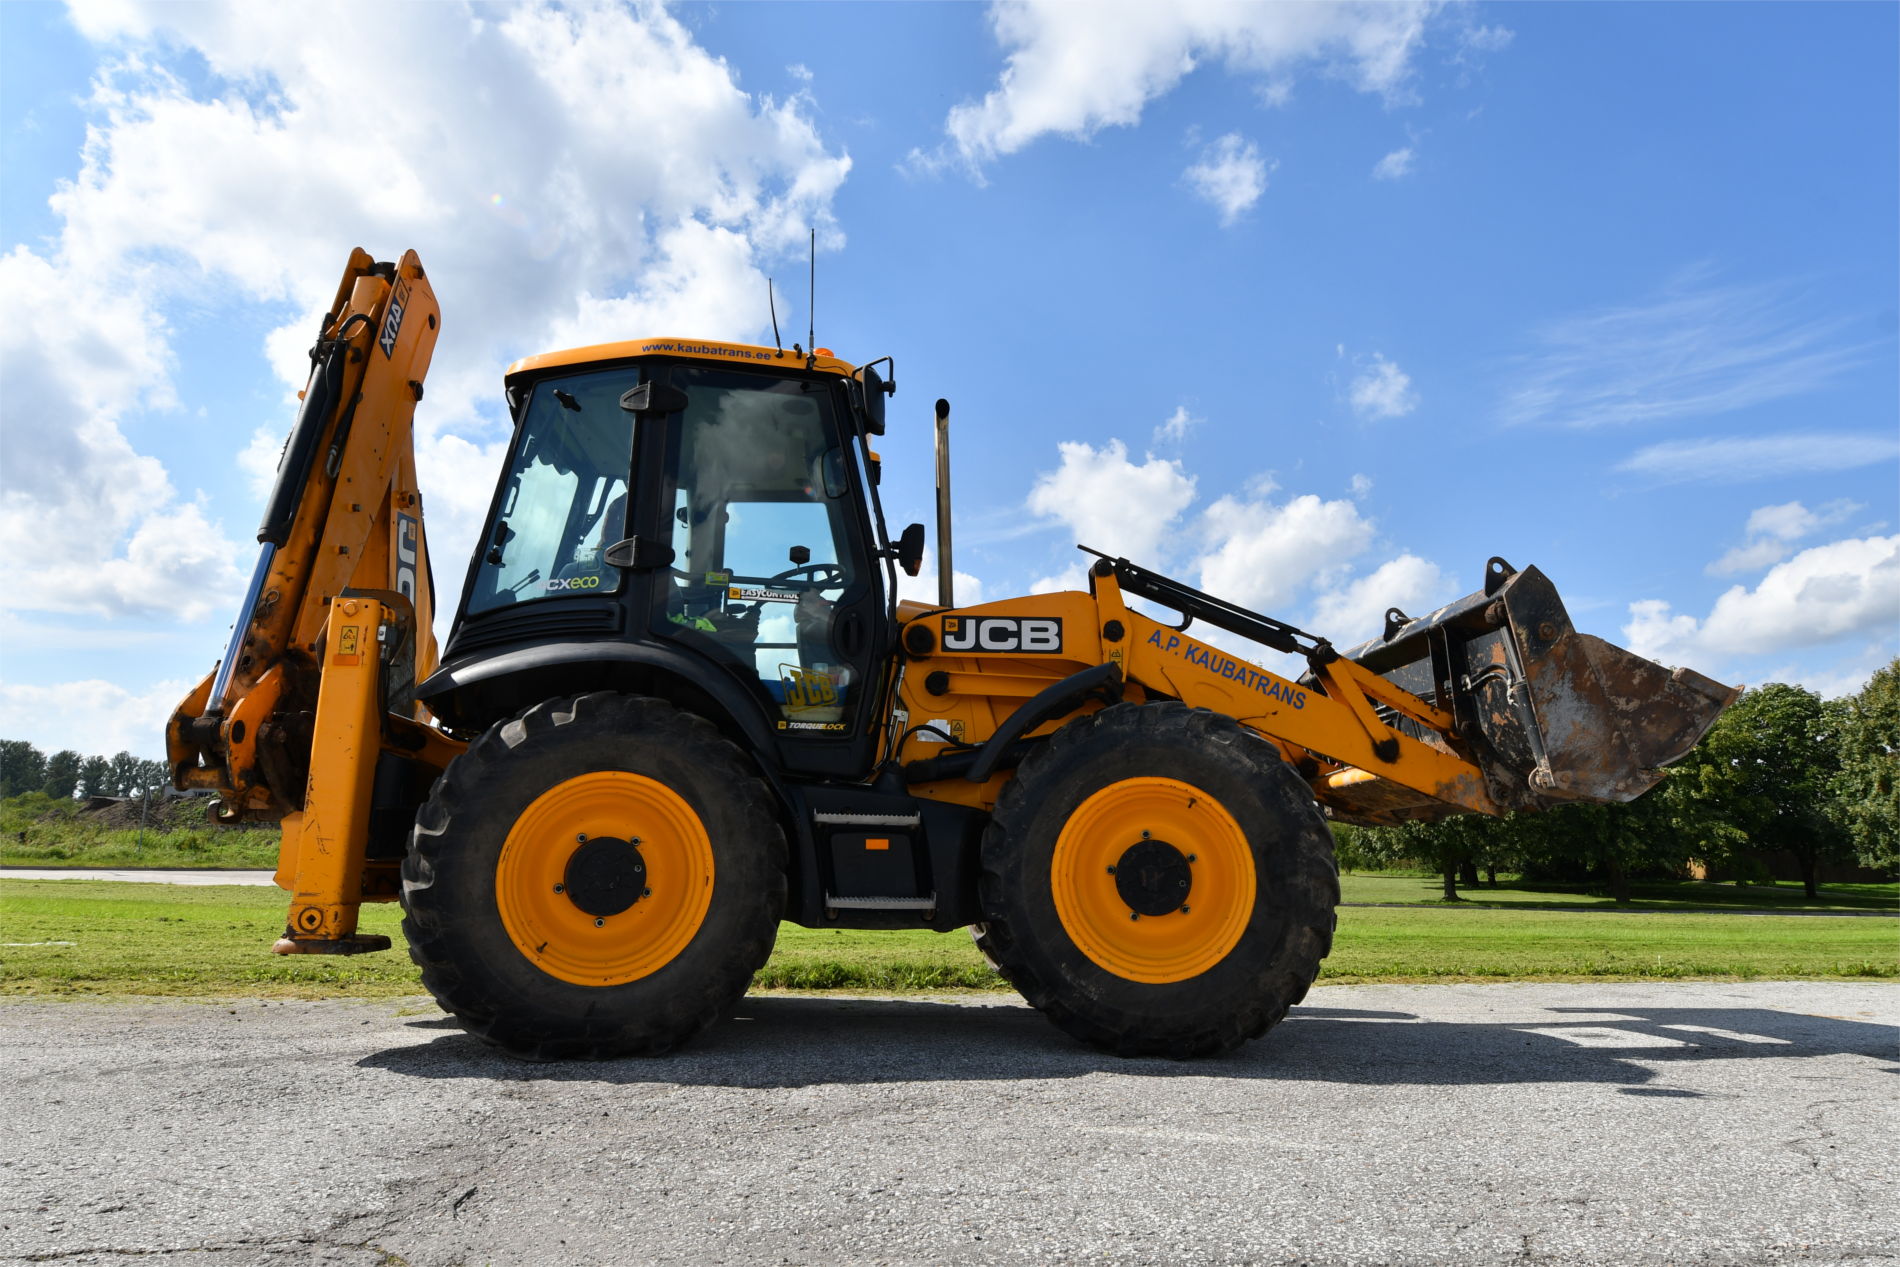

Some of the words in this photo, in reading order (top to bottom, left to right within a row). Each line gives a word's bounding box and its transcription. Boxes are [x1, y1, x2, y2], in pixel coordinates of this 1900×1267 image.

[642, 343, 771, 360] www.kaubatrans.ee
[397, 519, 415, 608] JC
[945, 619, 1060, 650] JCB
[1147, 629, 1180, 656] A.P.
[1184, 644, 1307, 710] KAUBATRANS
[789, 670, 833, 706] JCB
[788, 722, 846, 730] TORQUELOCK
